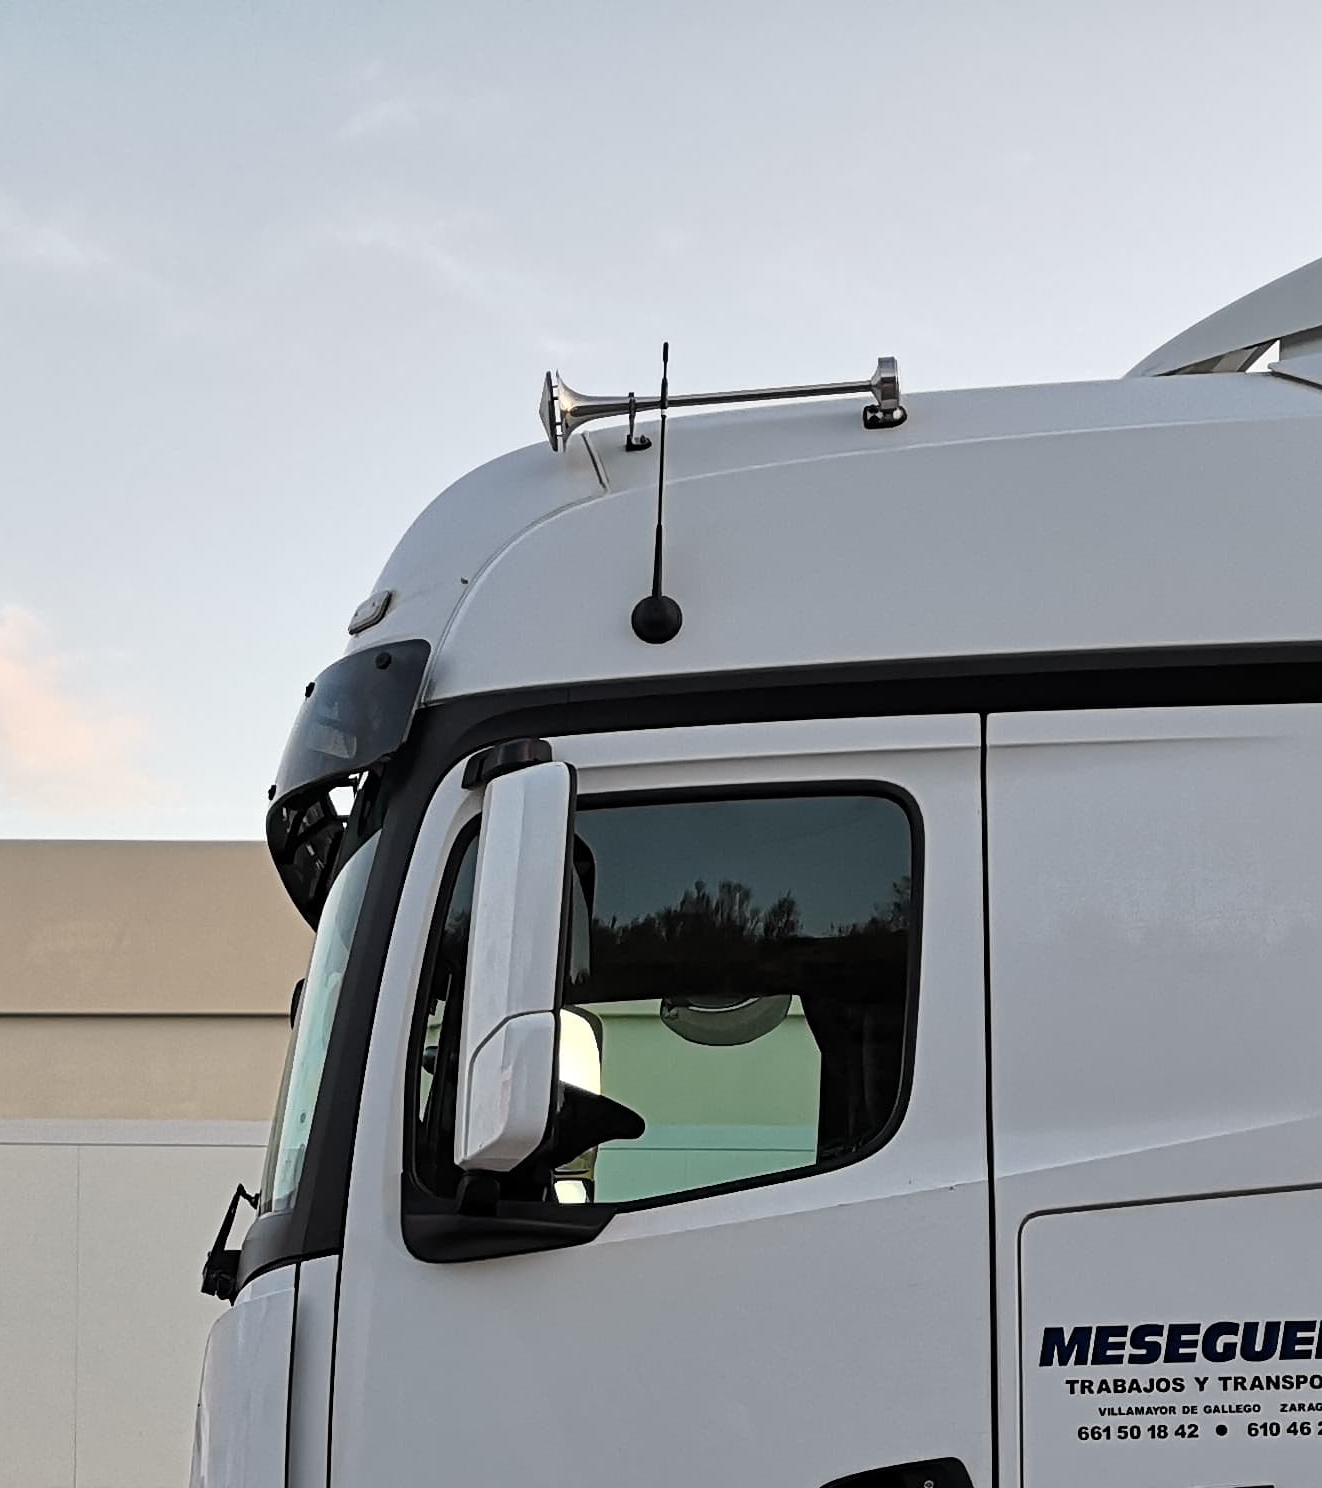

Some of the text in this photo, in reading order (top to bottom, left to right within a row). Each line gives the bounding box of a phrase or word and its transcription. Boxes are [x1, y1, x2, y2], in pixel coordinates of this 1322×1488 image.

[1065, 1377, 1185, 1395] TRABAJOS
[1194, 1376, 1209, 1392] Y
[1098, 1405, 1177, 1417] VILLAMAYOR
[1182, 1405, 1198, 1415] DE
[1203, 1403, 1262, 1415] GALLEGO
[1077, 1425, 1111, 1441] 661
[1117, 1425, 1141, 1439] 50
[1147, 1424, 1169, 1439] 18
[1174, 1423, 1199, 1438] 42
[1247, 1421, 1281, 1437] 610
[1286, 1421, 1312, 1436] 46
